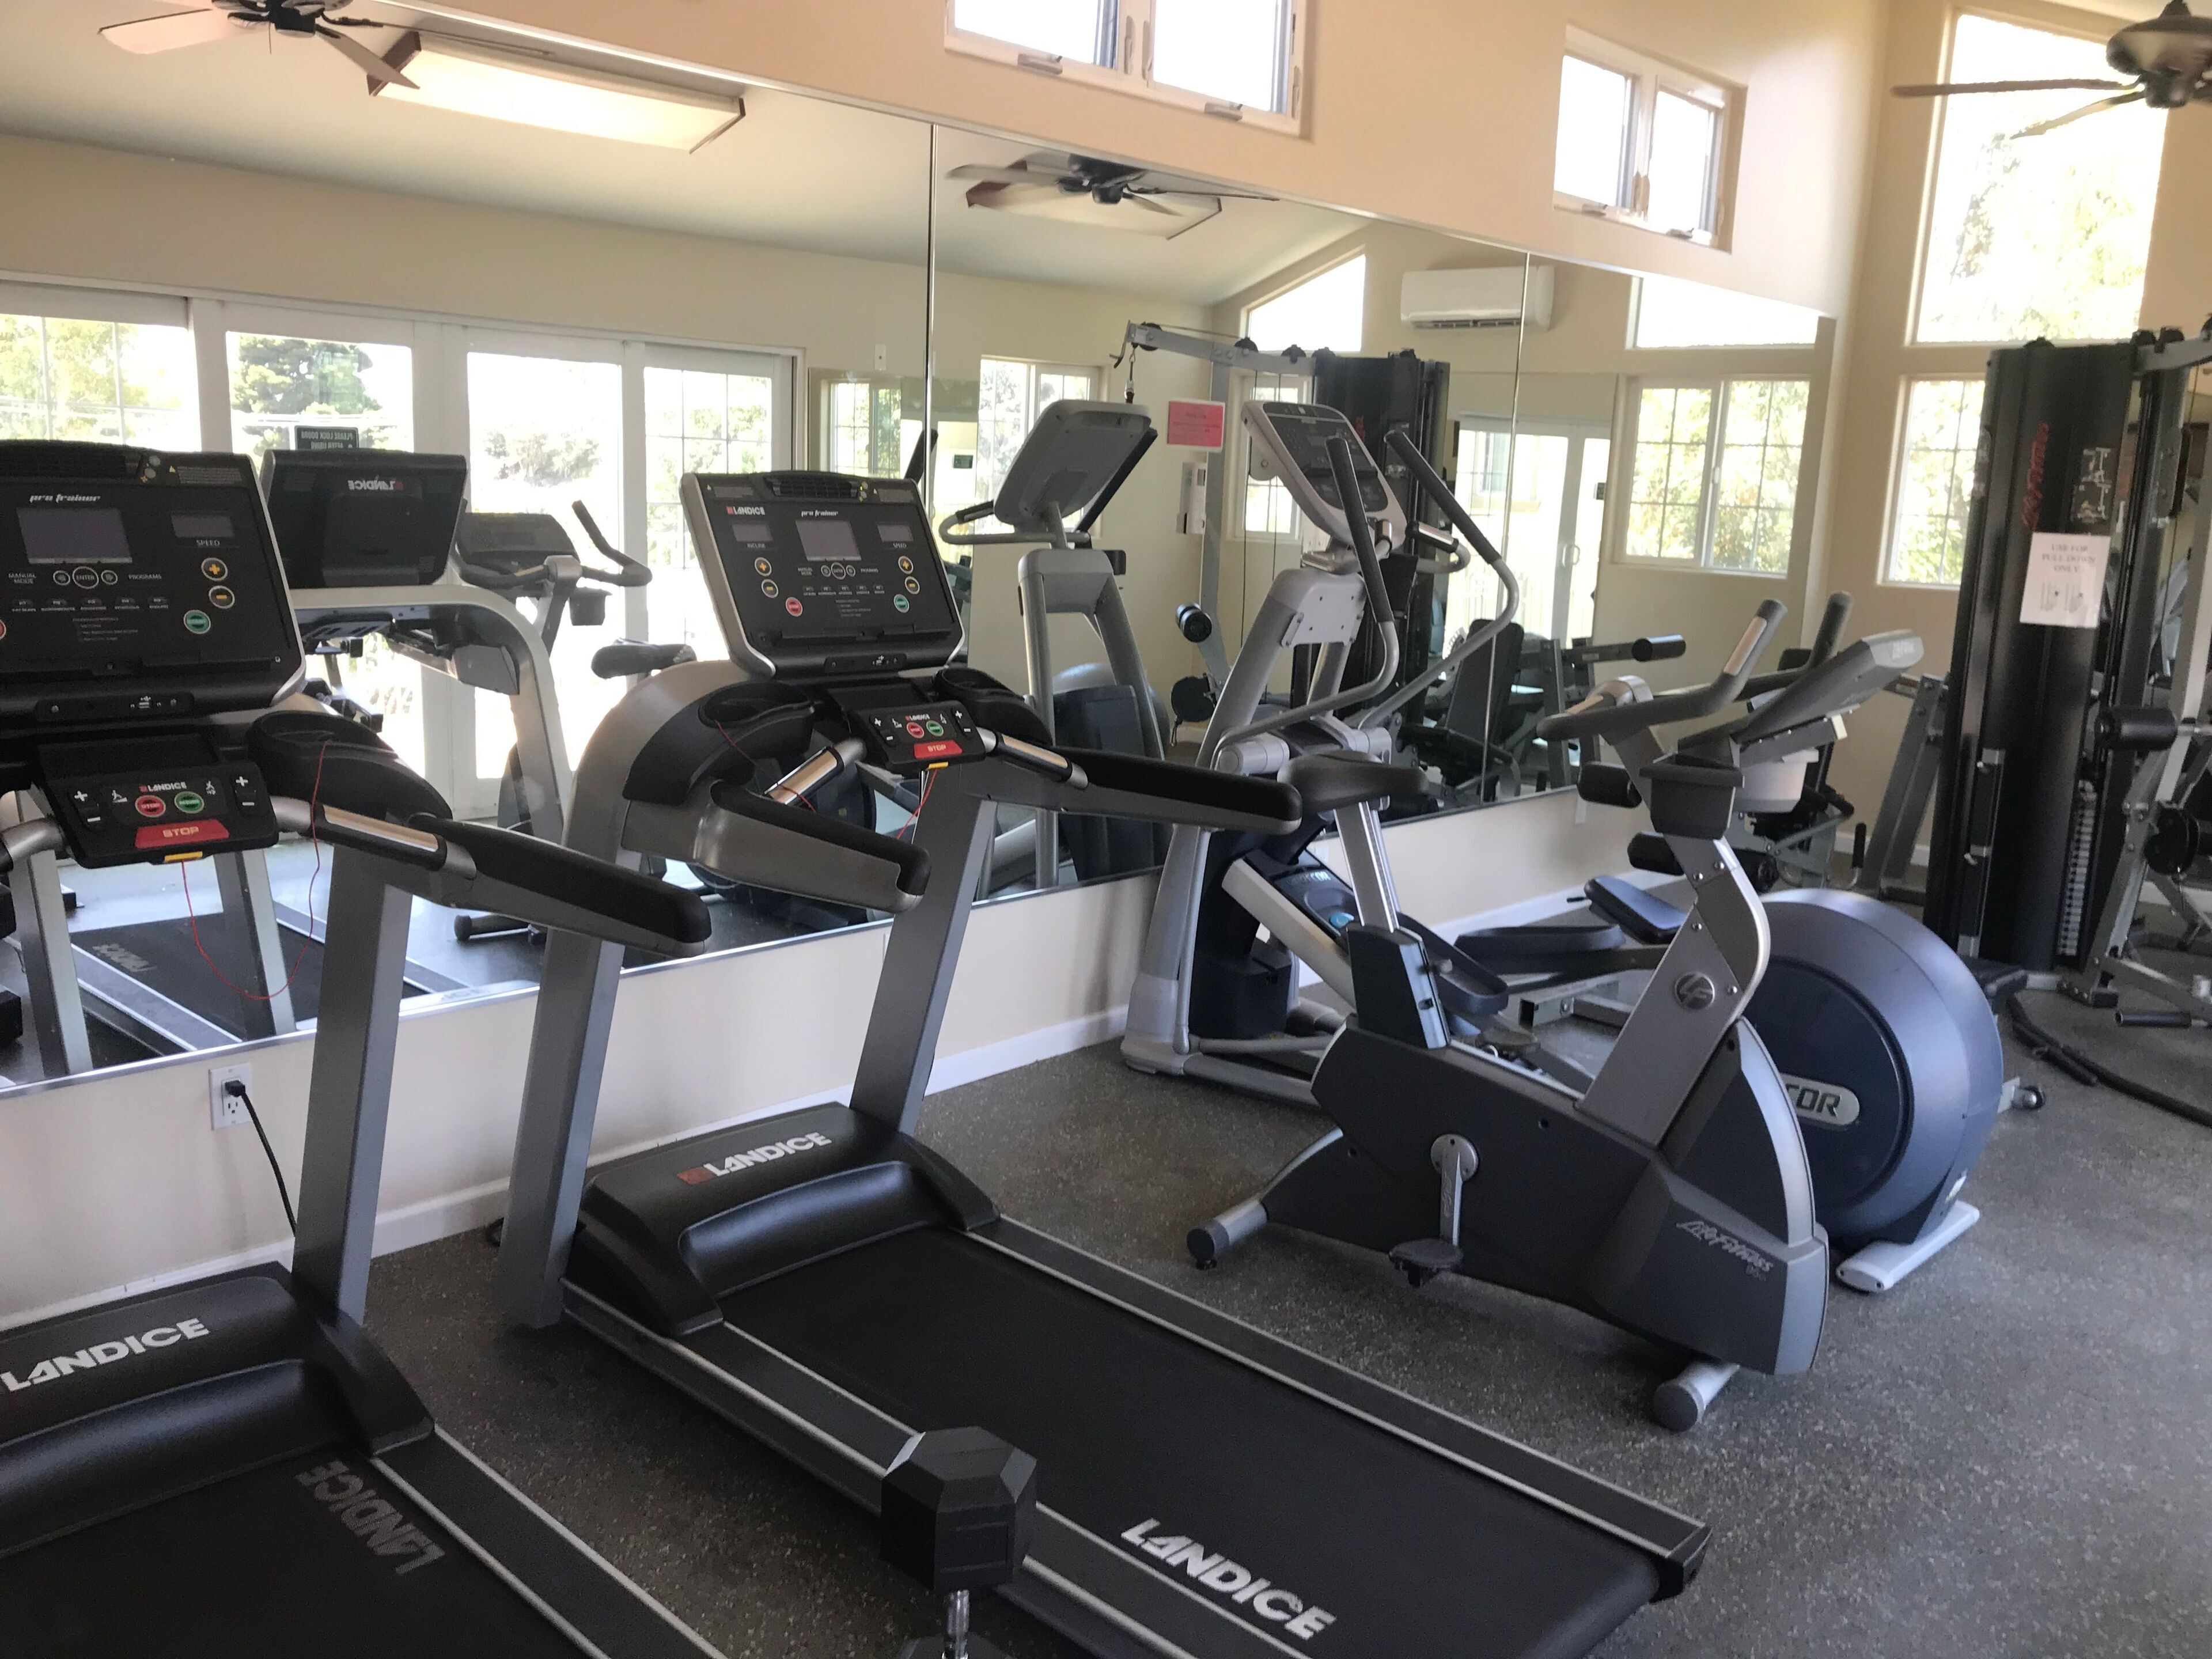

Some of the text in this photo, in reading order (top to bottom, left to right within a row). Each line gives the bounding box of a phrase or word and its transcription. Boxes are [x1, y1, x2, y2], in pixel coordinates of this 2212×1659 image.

[733, 506, 766, 515] LANDICE
[927, 744, 946, 752] STOP
[147, 782, 187, 791] LANDICE
[162, 827, 199, 838] STOP
[703, 1132, 832, 1176] LANDICE
[1, 1317, 210, 1393] LANDICE
[294, 1460, 446, 1575] LANDICE
[1121, 1517, 1338, 1641] LANDICE
